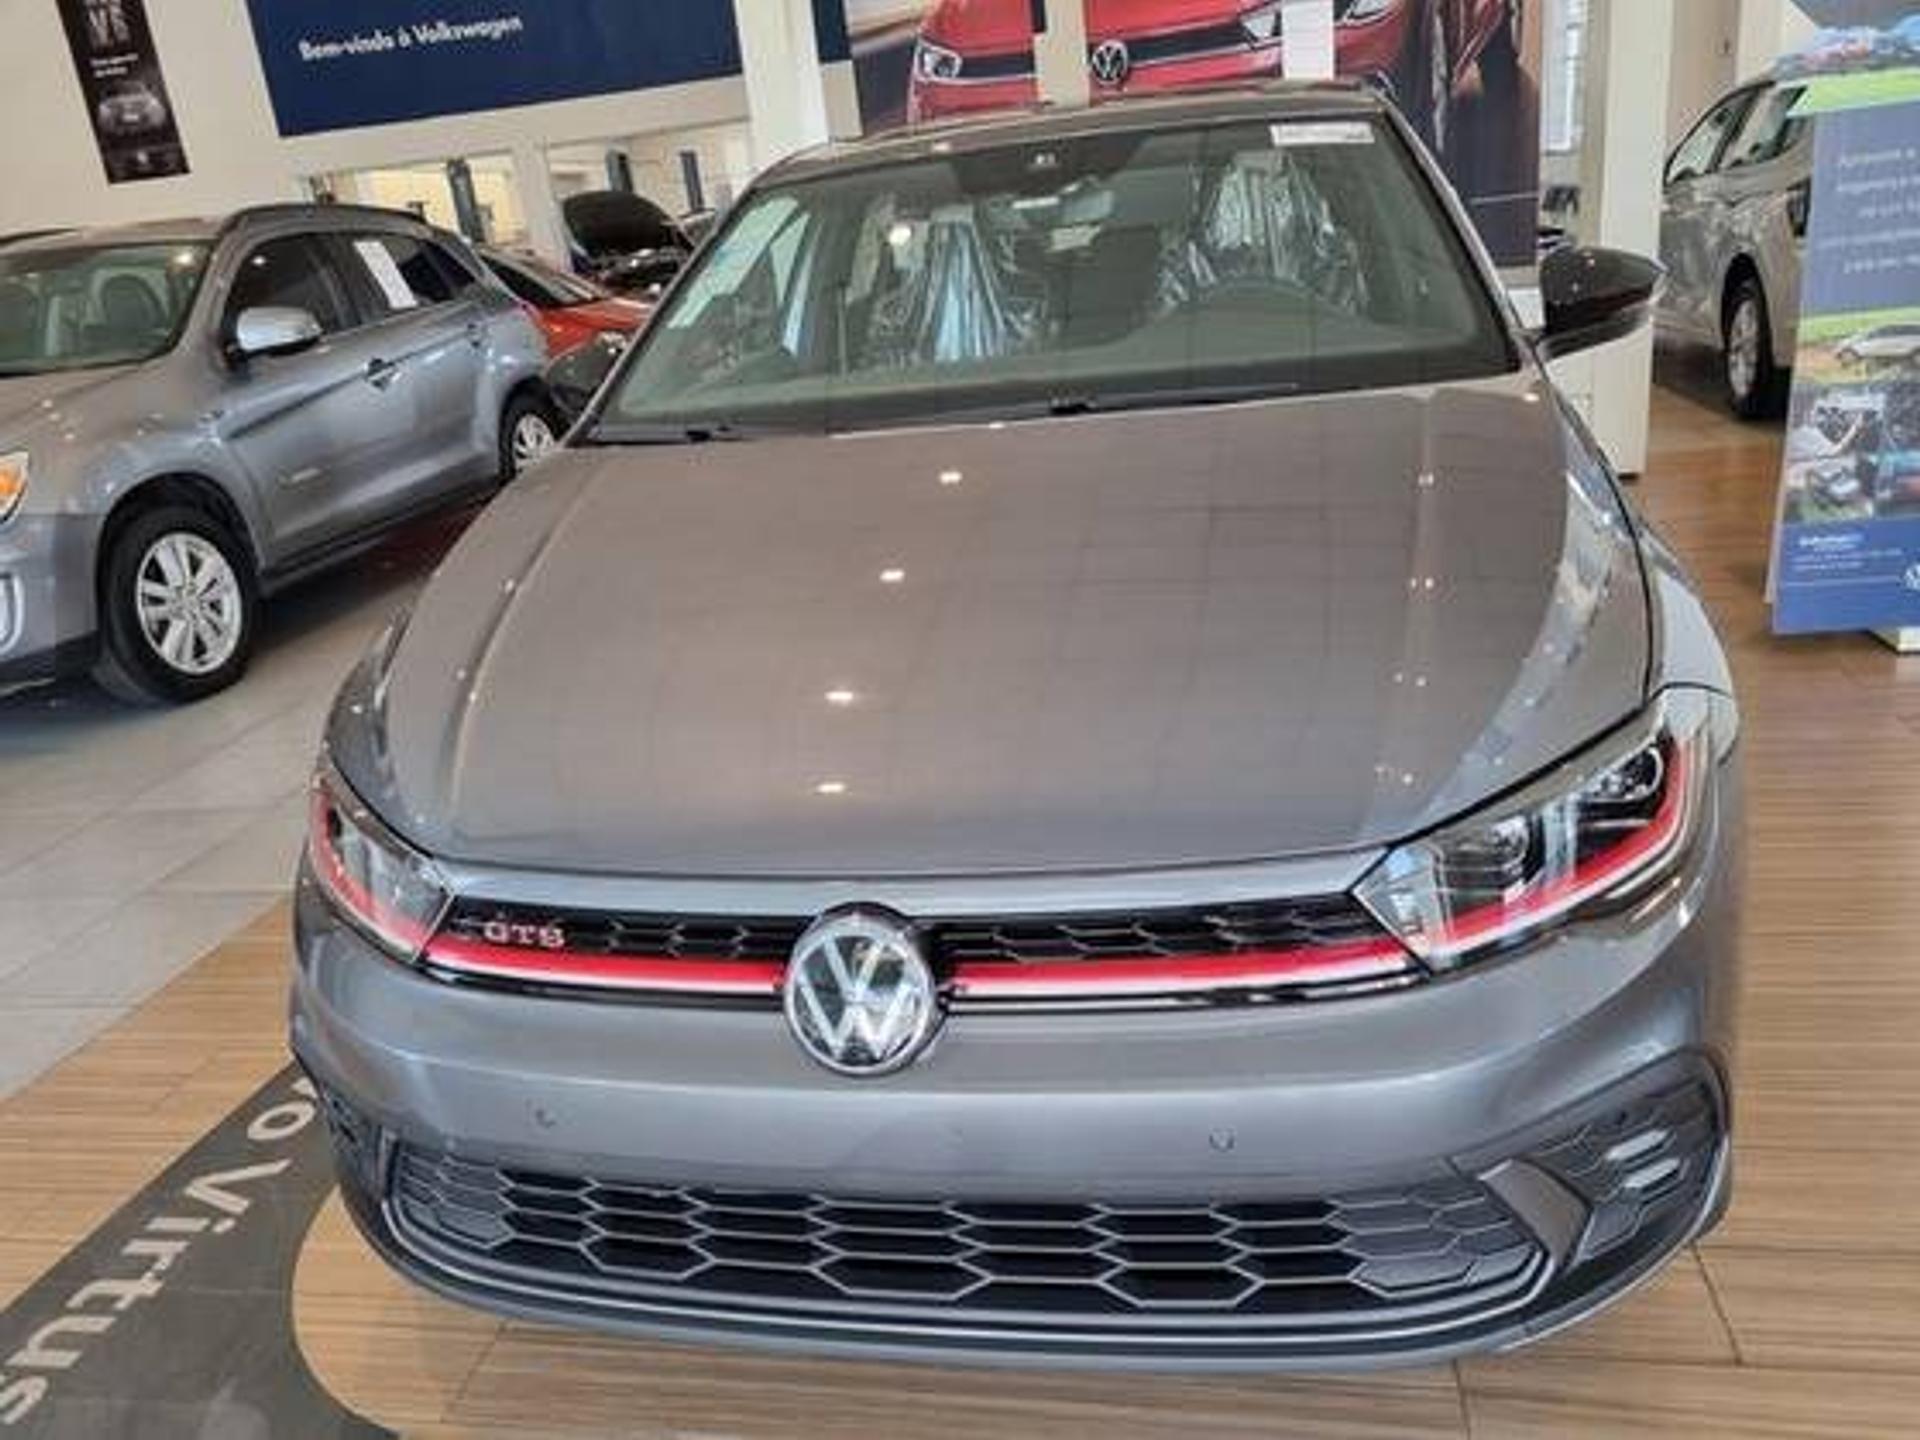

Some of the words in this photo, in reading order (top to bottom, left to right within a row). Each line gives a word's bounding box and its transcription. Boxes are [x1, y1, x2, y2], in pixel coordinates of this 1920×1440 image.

[412, 16, 523, 43] Volkswagen
[484, 920, 565, 948] GTS
[0, 1158, 292, 1425] Virtus
